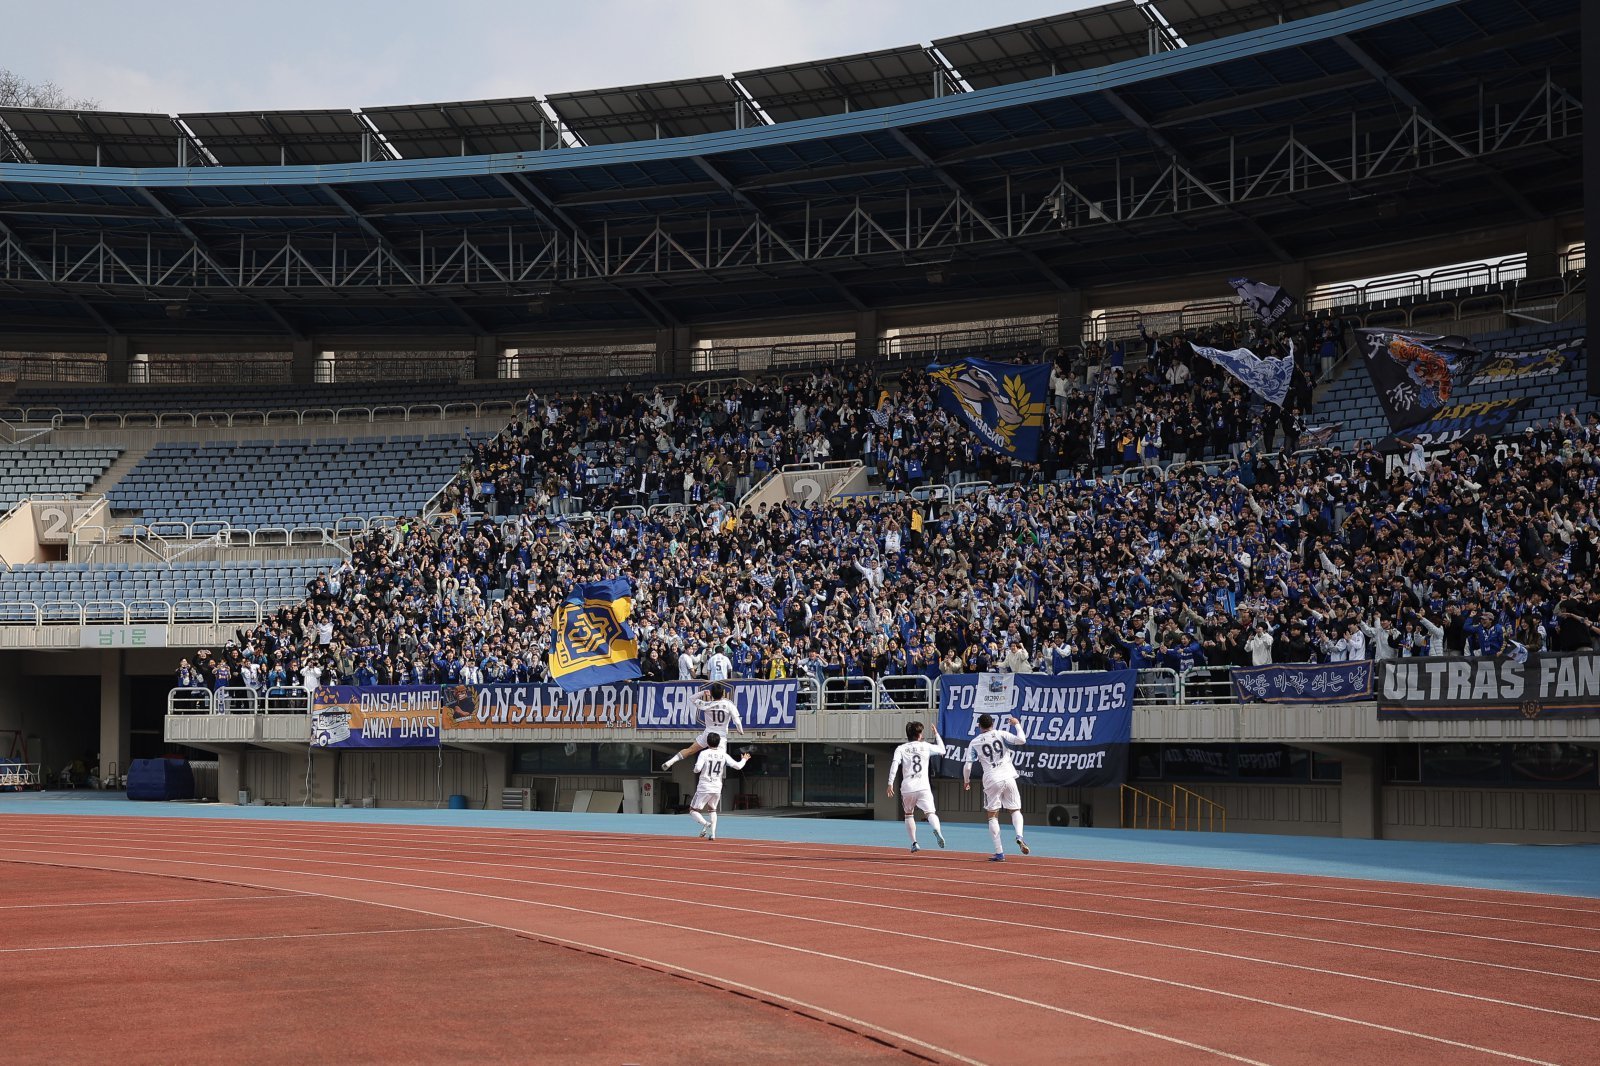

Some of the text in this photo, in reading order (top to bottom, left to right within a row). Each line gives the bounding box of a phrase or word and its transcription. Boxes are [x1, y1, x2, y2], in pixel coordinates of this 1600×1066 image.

[40, 508, 71, 539] 2
[716, 661, 722, 671] 5
[1383, 655, 1600, 701] ULTRAS FAN
[360, 690, 440, 713] ONSAEMIRO
[477, 685, 634, 723] ONSAEMIRO
[638, 686, 698, 725] ULSAN
[948, 685, 976, 710] FO
[1021, 682, 1126, 714] MINUTES,
[361, 715, 436, 739] AWAY DAYS
[711, 709, 726, 724] 10
[1019, 715, 1096, 742] ULSAN
[981, 740, 1004, 762] 99
[1037, 751, 1106, 770] SUPPORT
[708, 760, 722, 778] 14
[912, 754, 922, 773] 8
